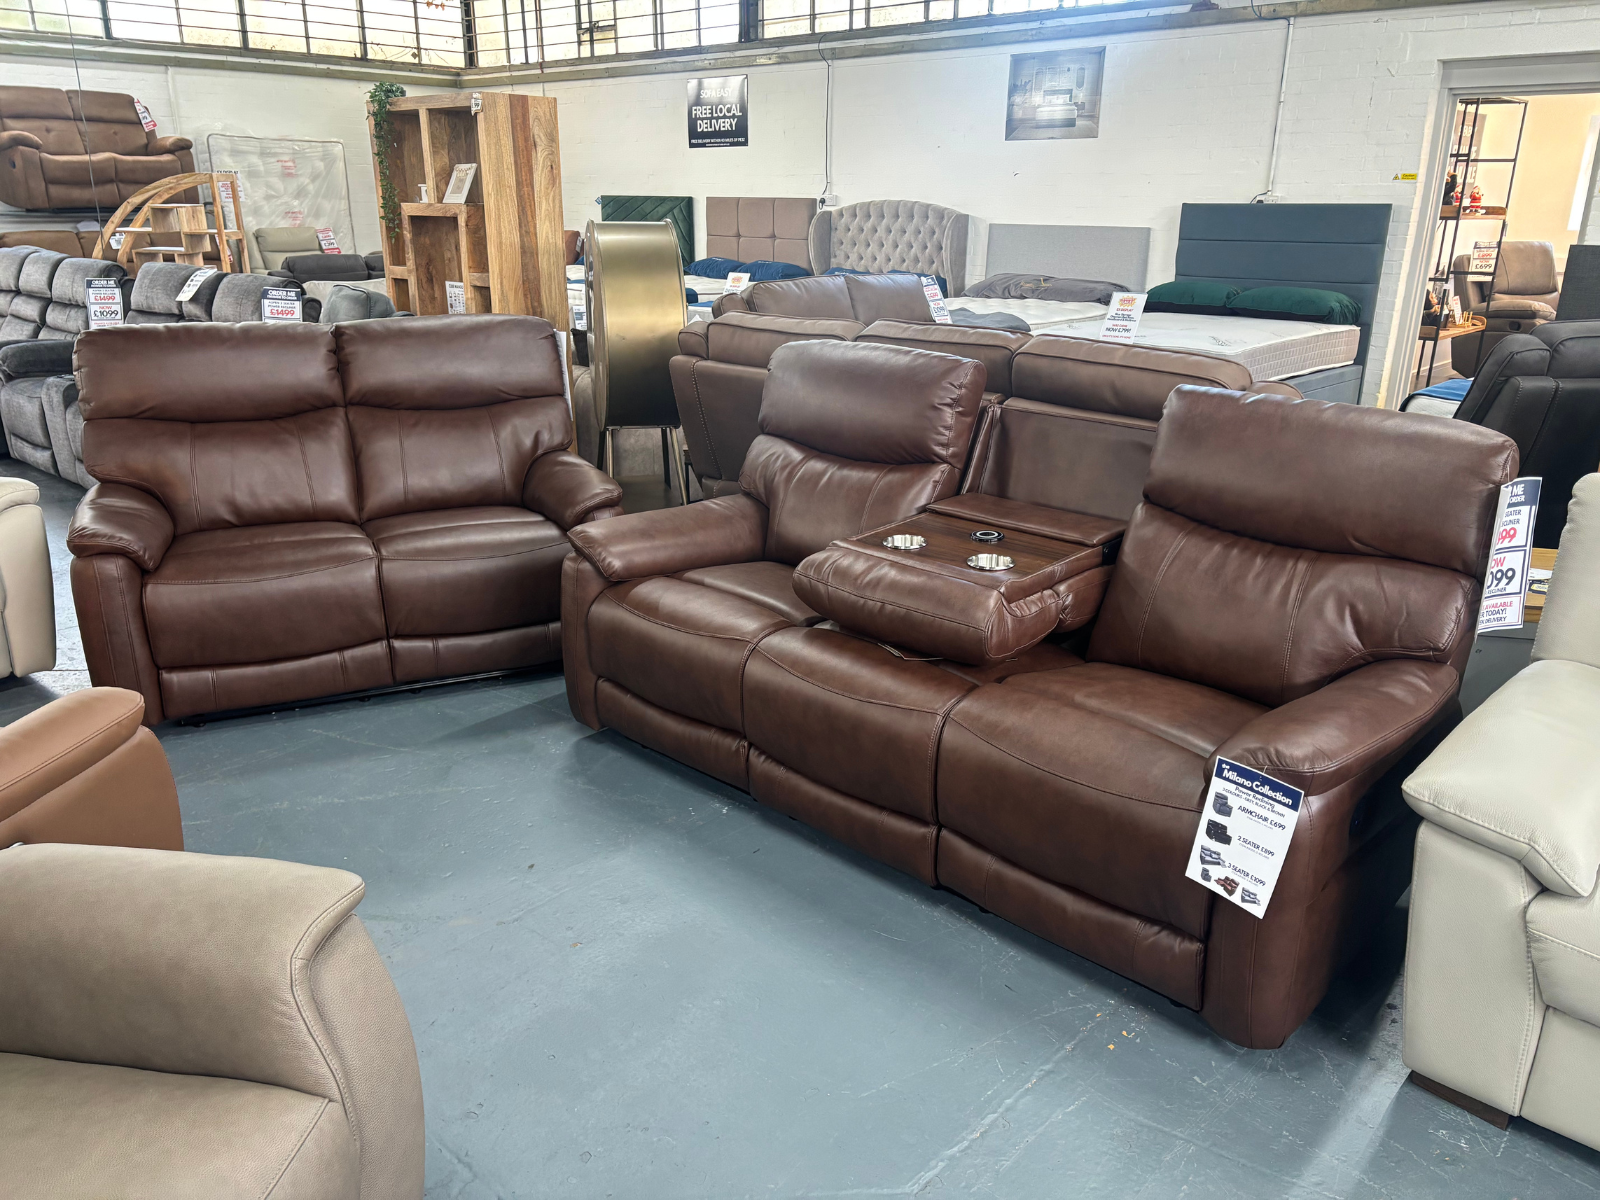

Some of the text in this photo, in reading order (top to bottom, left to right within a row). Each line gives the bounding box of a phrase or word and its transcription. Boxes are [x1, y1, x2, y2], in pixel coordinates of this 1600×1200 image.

[700, 88, 732, 98] SOFA EASY
[692, 104, 742, 118] FREE LOCAL
[697, 118, 738, 132] DELIVERY
[94, 310, 119, 318] £1099
[1512, 484, 1524, 496] ME
[1491, 556, 1506, 569] OW
[1487, 568, 1516, 590] 099
[1485, 601, 1513, 610] AVAILABLE
[1486, 608, 1507, 617] TODAY!
[1485, 616, 1507, 624] DELIVERY
[1222, 769, 1292, 806] Milano Collection
[1235, 786, 1252, 797] Power
[1254, 801, 1267, 810] BLACK
[1270, 809, 1286, 818] BROWN
[1238, 805, 1269, 823] ARMCHAIR
[1270, 820, 1286, 830] £699
[1241, 837, 1261, 850] SEATER
[1261, 846, 1275, 857] £899
[1231, 865, 1250, 879] SEATER
[1250, 874, 1266, 886] £1099
